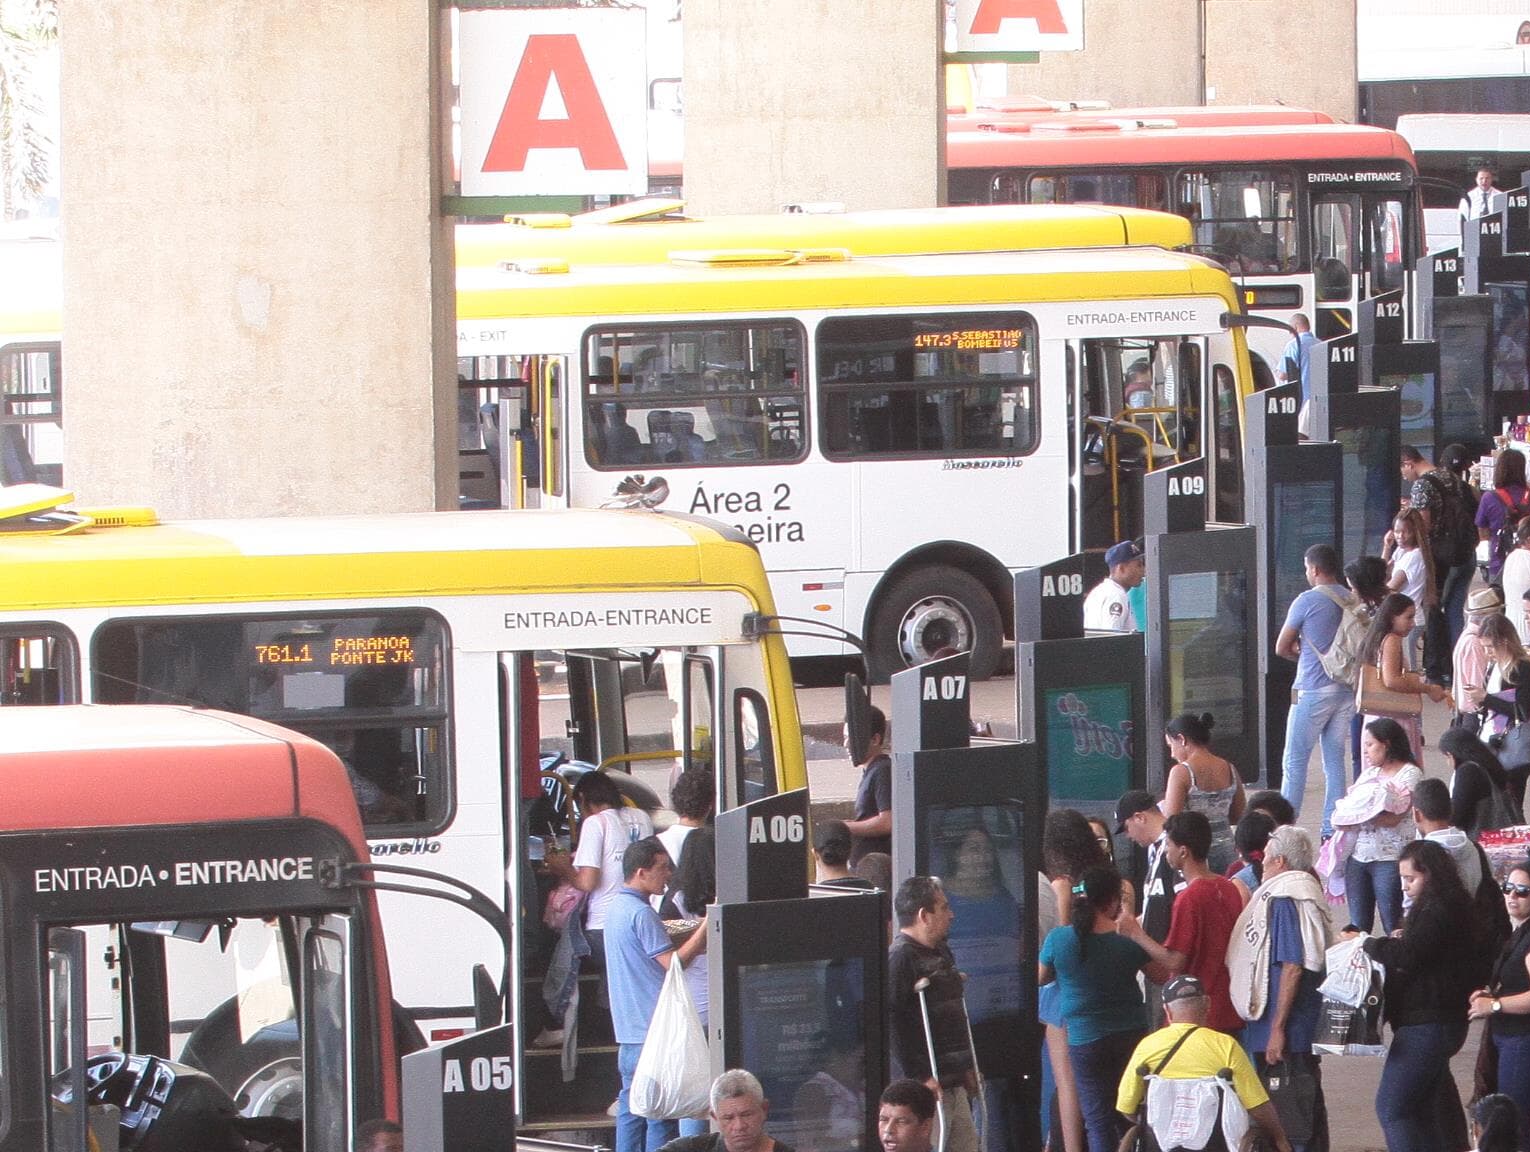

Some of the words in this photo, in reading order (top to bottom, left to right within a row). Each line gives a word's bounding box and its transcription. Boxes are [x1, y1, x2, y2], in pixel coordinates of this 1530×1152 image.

[481, 34, 627, 172] A
[1308, 173, 1349, 183] ENTRADA
[1355, 172, 1402, 182] ENTRANCE
[1509, 196, 1515, 207] A
[1516, 195, 1528, 207] 15
[1481, 223, 1488, 235] A
[1489, 222, 1501, 235] 14
[1434, 260, 1443, 273] A
[1444, 259, 1457, 272] 13
[1067, 310, 1197, 325] ENTRADA-ENTRANCE
[1376, 304, 1385, 317] A
[1386, 303, 1400, 317] 12
[480, 331, 507, 342] EXIT
[914, 334, 952, 347] 147.3
[1331, 347, 1341, 362] A
[1342, 346, 1355, 362] 11
[1268, 397, 1278, 414] A
[1281, 396, 1296, 413] 10
[1168, 477, 1180, 496] A
[1182, 476, 1204, 495] 09
[689, 480, 763, 514] Área
[774, 483, 791, 511] 2
[1042, 575, 1056, 596] A
[1058, 573, 1083, 596] 08
[504, 607, 712, 630] ENTRADA-ENTRANCE
[255, 644, 312, 663] 761.1
[334, 636, 411, 651] PARANOA
[330, 650, 386, 665] PONTE
[390, 648, 415, 664] JK
[923, 677, 938, 700] A
[941, 676, 966, 700] 07
[749, 816, 767, 844] A
[770, 815, 804, 842] 06
[35, 866, 155, 893] ENTRADA
[175, 856, 314, 886] ENTRANCE
[443, 1059, 464, 1093] A
[471, 1056, 512, 1092] 05
